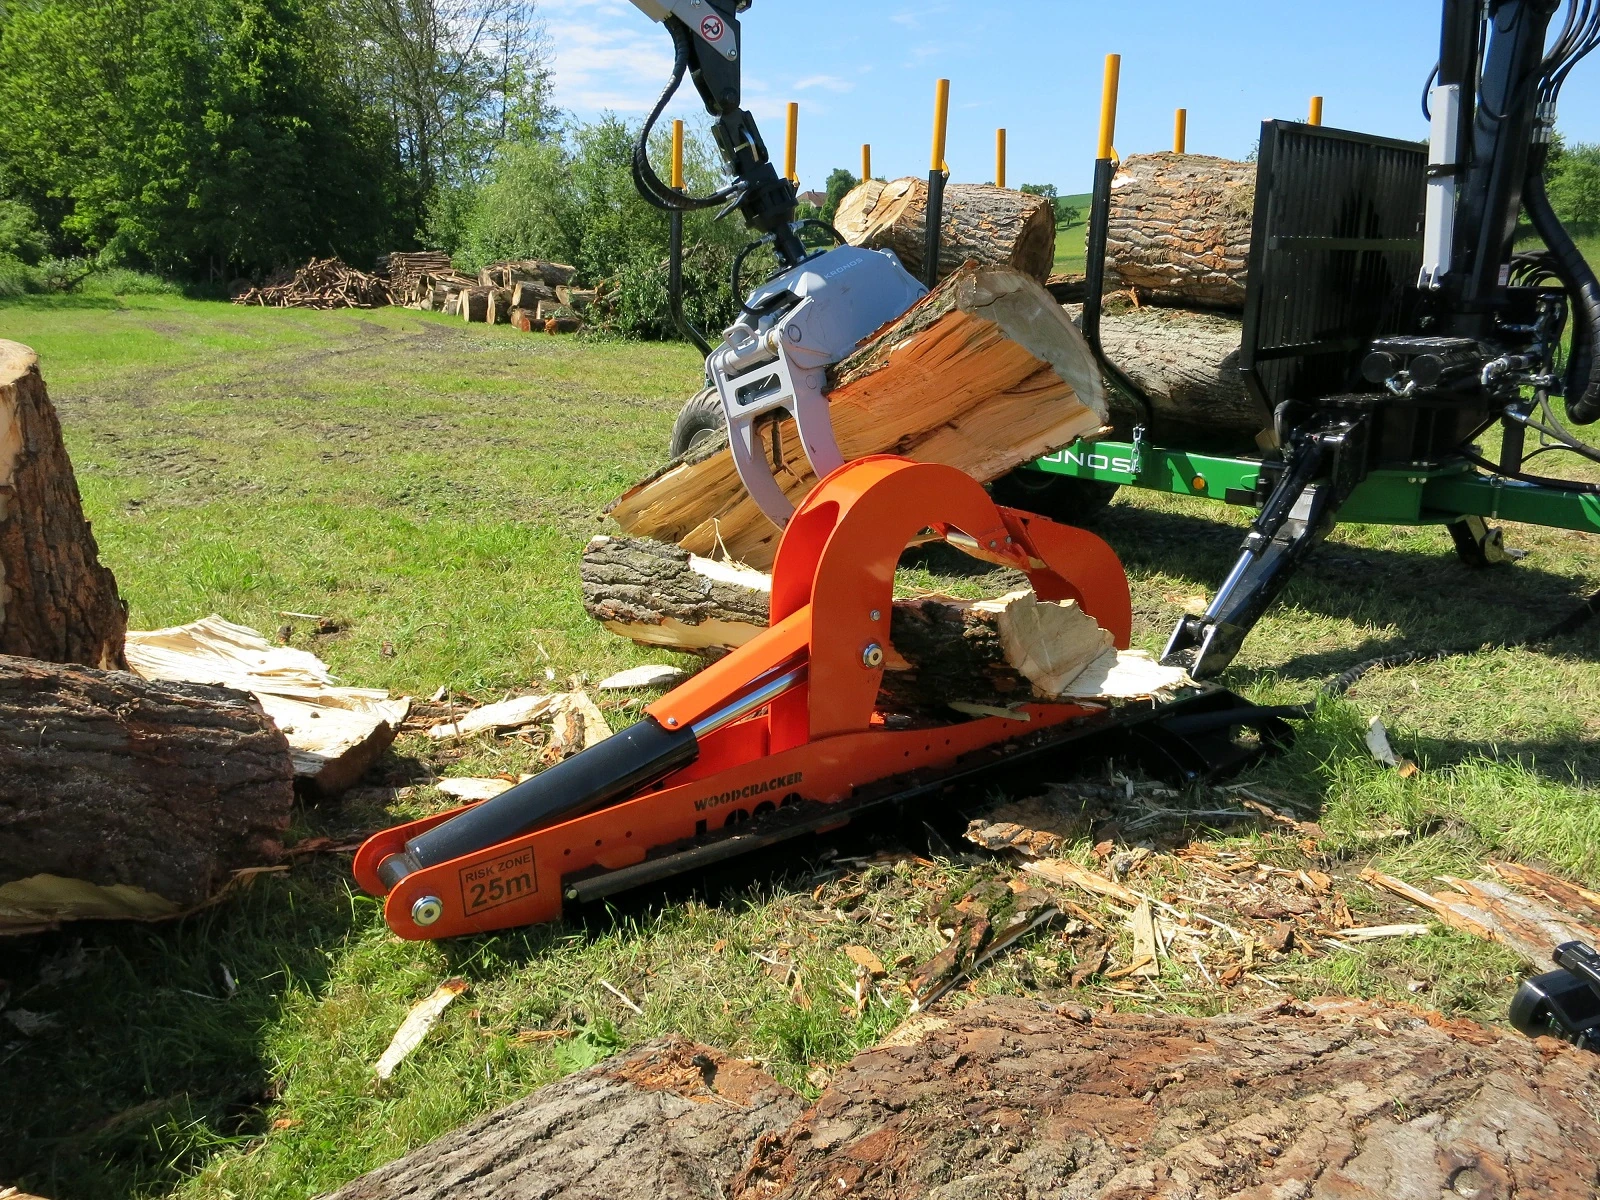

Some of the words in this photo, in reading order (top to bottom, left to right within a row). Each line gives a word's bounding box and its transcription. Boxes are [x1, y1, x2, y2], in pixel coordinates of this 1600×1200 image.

[823, 257, 863, 280] KRONOS
[694, 772, 803, 811] WOODCRACKER
[465, 865, 494, 883] RISK
[498, 854, 531, 872] ZONE
[470, 873, 532, 909] 25m
